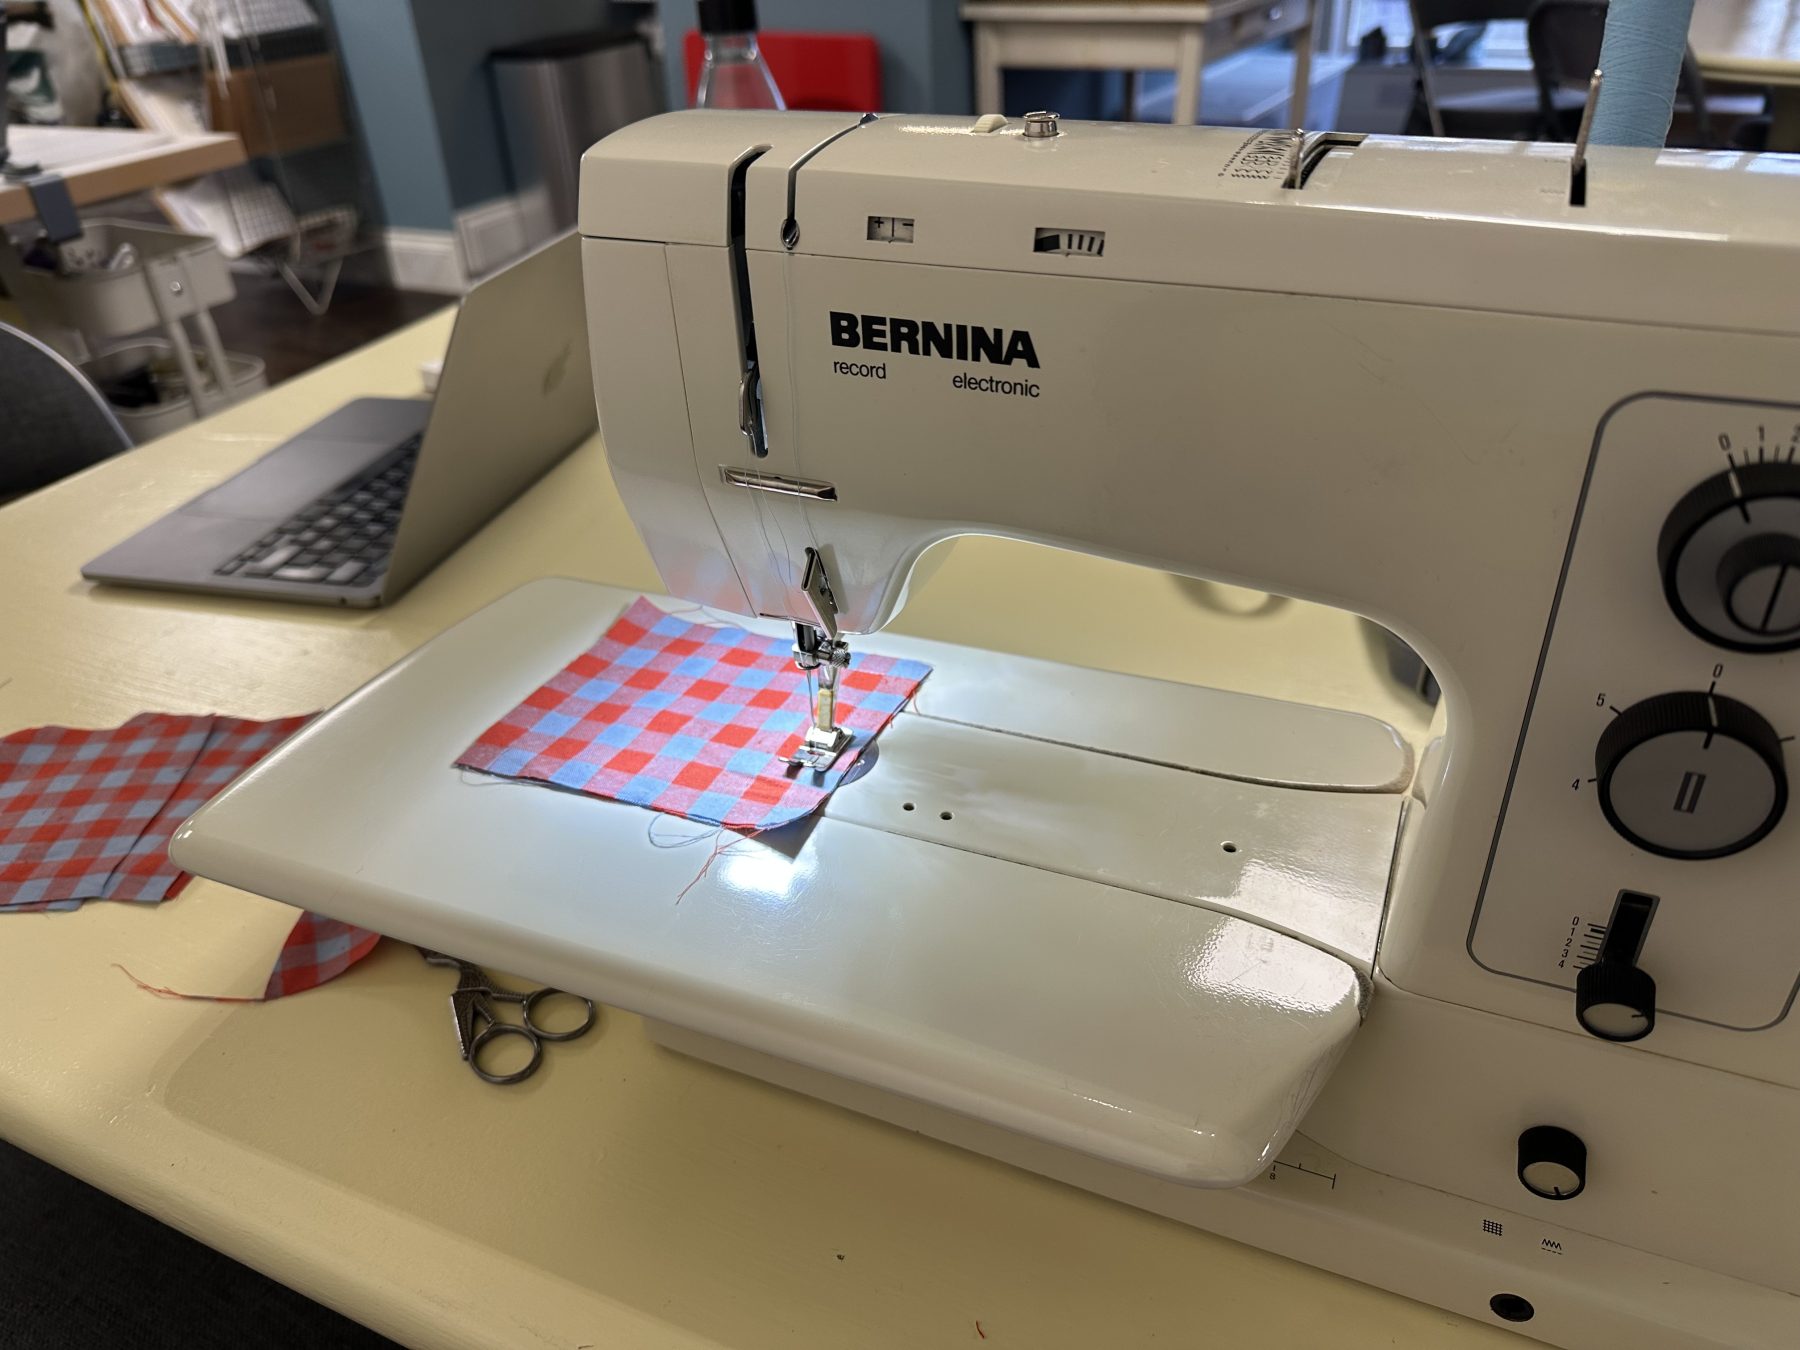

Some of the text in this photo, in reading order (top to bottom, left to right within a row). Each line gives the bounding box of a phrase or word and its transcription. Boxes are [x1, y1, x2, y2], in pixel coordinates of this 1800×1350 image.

[829, 310, 1041, 369] BERNINA
[832, 359, 1041, 399] record electronic
[1718, 432, 1731, 452] 0
[1758, 424, 1765, 442] 1
[1712, 663, 1724, 679] 0
[1596, 693, 1607, 708] 5
[1571, 778, 1581, 791] 4
[1572, 916, 1580, 926] 0
[1570, 927, 1576, 937] 1
[1564, 937, 1573, 948] 2
[1561, 948, 1569, 958] 3
[1558, 959, 1566, 969] 4
